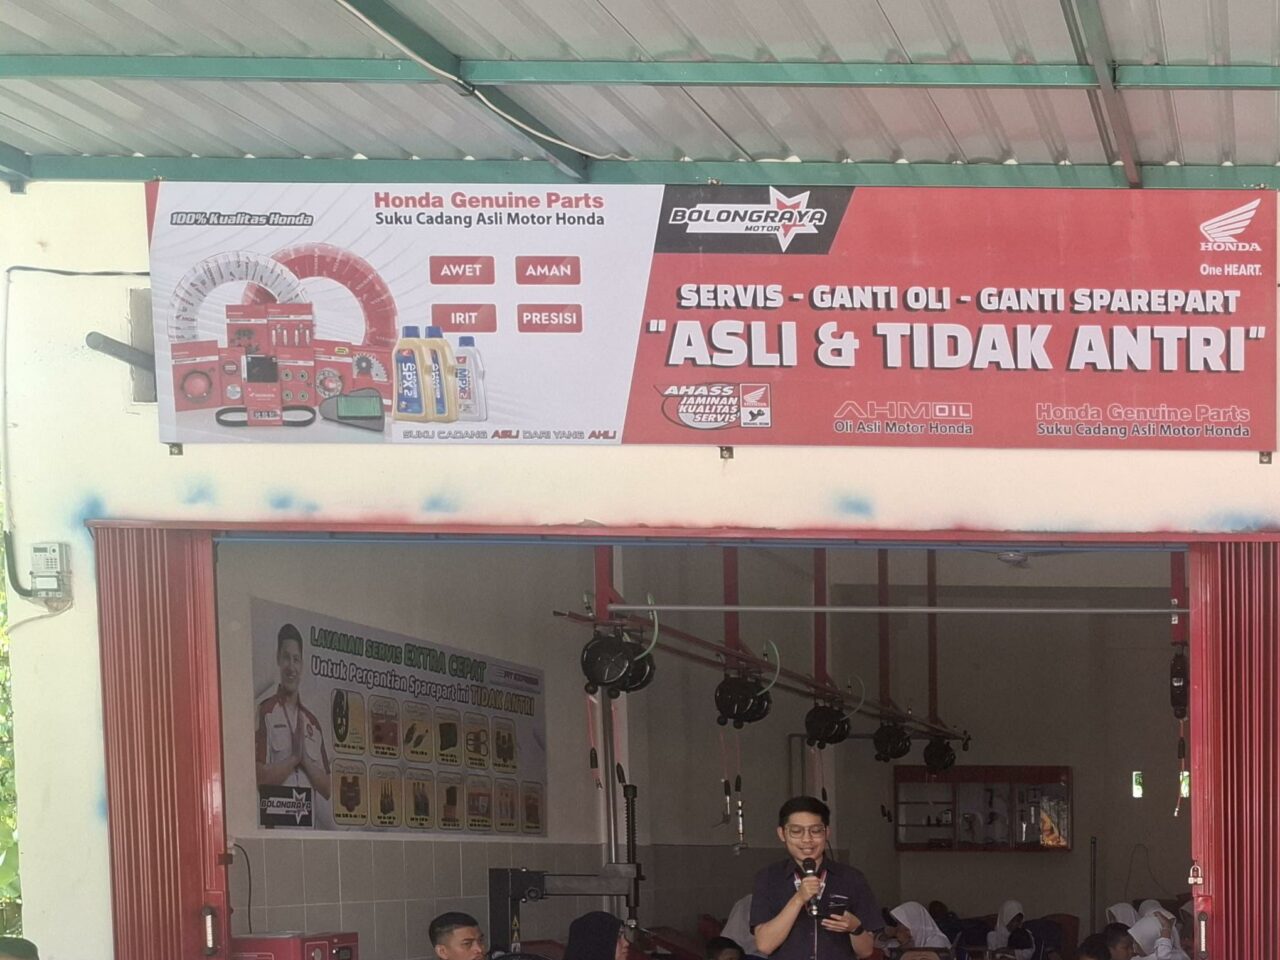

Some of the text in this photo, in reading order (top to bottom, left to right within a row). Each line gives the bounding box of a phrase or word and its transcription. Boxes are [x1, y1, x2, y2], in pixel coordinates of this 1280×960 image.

[374, 192, 604, 209] Honda Genuine Parts
[171, 212, 313, 226] 100% Kualitas Honda
[375, 212, 605, 228] Suku Cadang Asli Motor Honda
[671, 208, 826, 225] BOLONGRAYA
[1200, 242, 1263, 252] HONDA
[440, 264, 482, 276] AWET
[525, 265, 571, 276] AMAN
[1200, 263, 1263, 276] One HEART.
[679, 283, 1241, 313] SERVIS GANTI OLI GANTI SPAREPART
[450, 312, 478, 324] IRIT
[523, 312, 577, 325] PRESISI
[816, 321, 860, 367] &
[875, 322, 1054, 370] TIDAK
[664, 386, 734, 396] AHASS
[680, 397, 738, 405] JAMINAN
[678, 405, 738, 413] KUALITAS
[834, 401, 972, 419] AHM OIL
[1036, 402, 1250, 422] Honda Genuine Parts
[402, 430, 435, 440] SUKU
[437, 430, 488, 440] CADANG
[523, 430, 550, 440] DARI
[553, 430, 585, 440] YANG
[834, 421, 974, 435] Oli Asli Motor Honda
[1037, 423, 1250, 439] Suku Cadang Asli Motor Honda
[311, 626, 364, 657] LAYANAN
[365, 638, 403, 665] SERVIS
[404, 643, 446, 674] EXTRA
[448, 653, 487, 682] CEPAT
[311, 654, 348, 680] Untuk
[349, 663, 408, 692] Pergantian
[408, 674, 457, 702] Sparepart
[457, 683, 470, 703] ini
[470, 684, 504, 711] TIDAK
